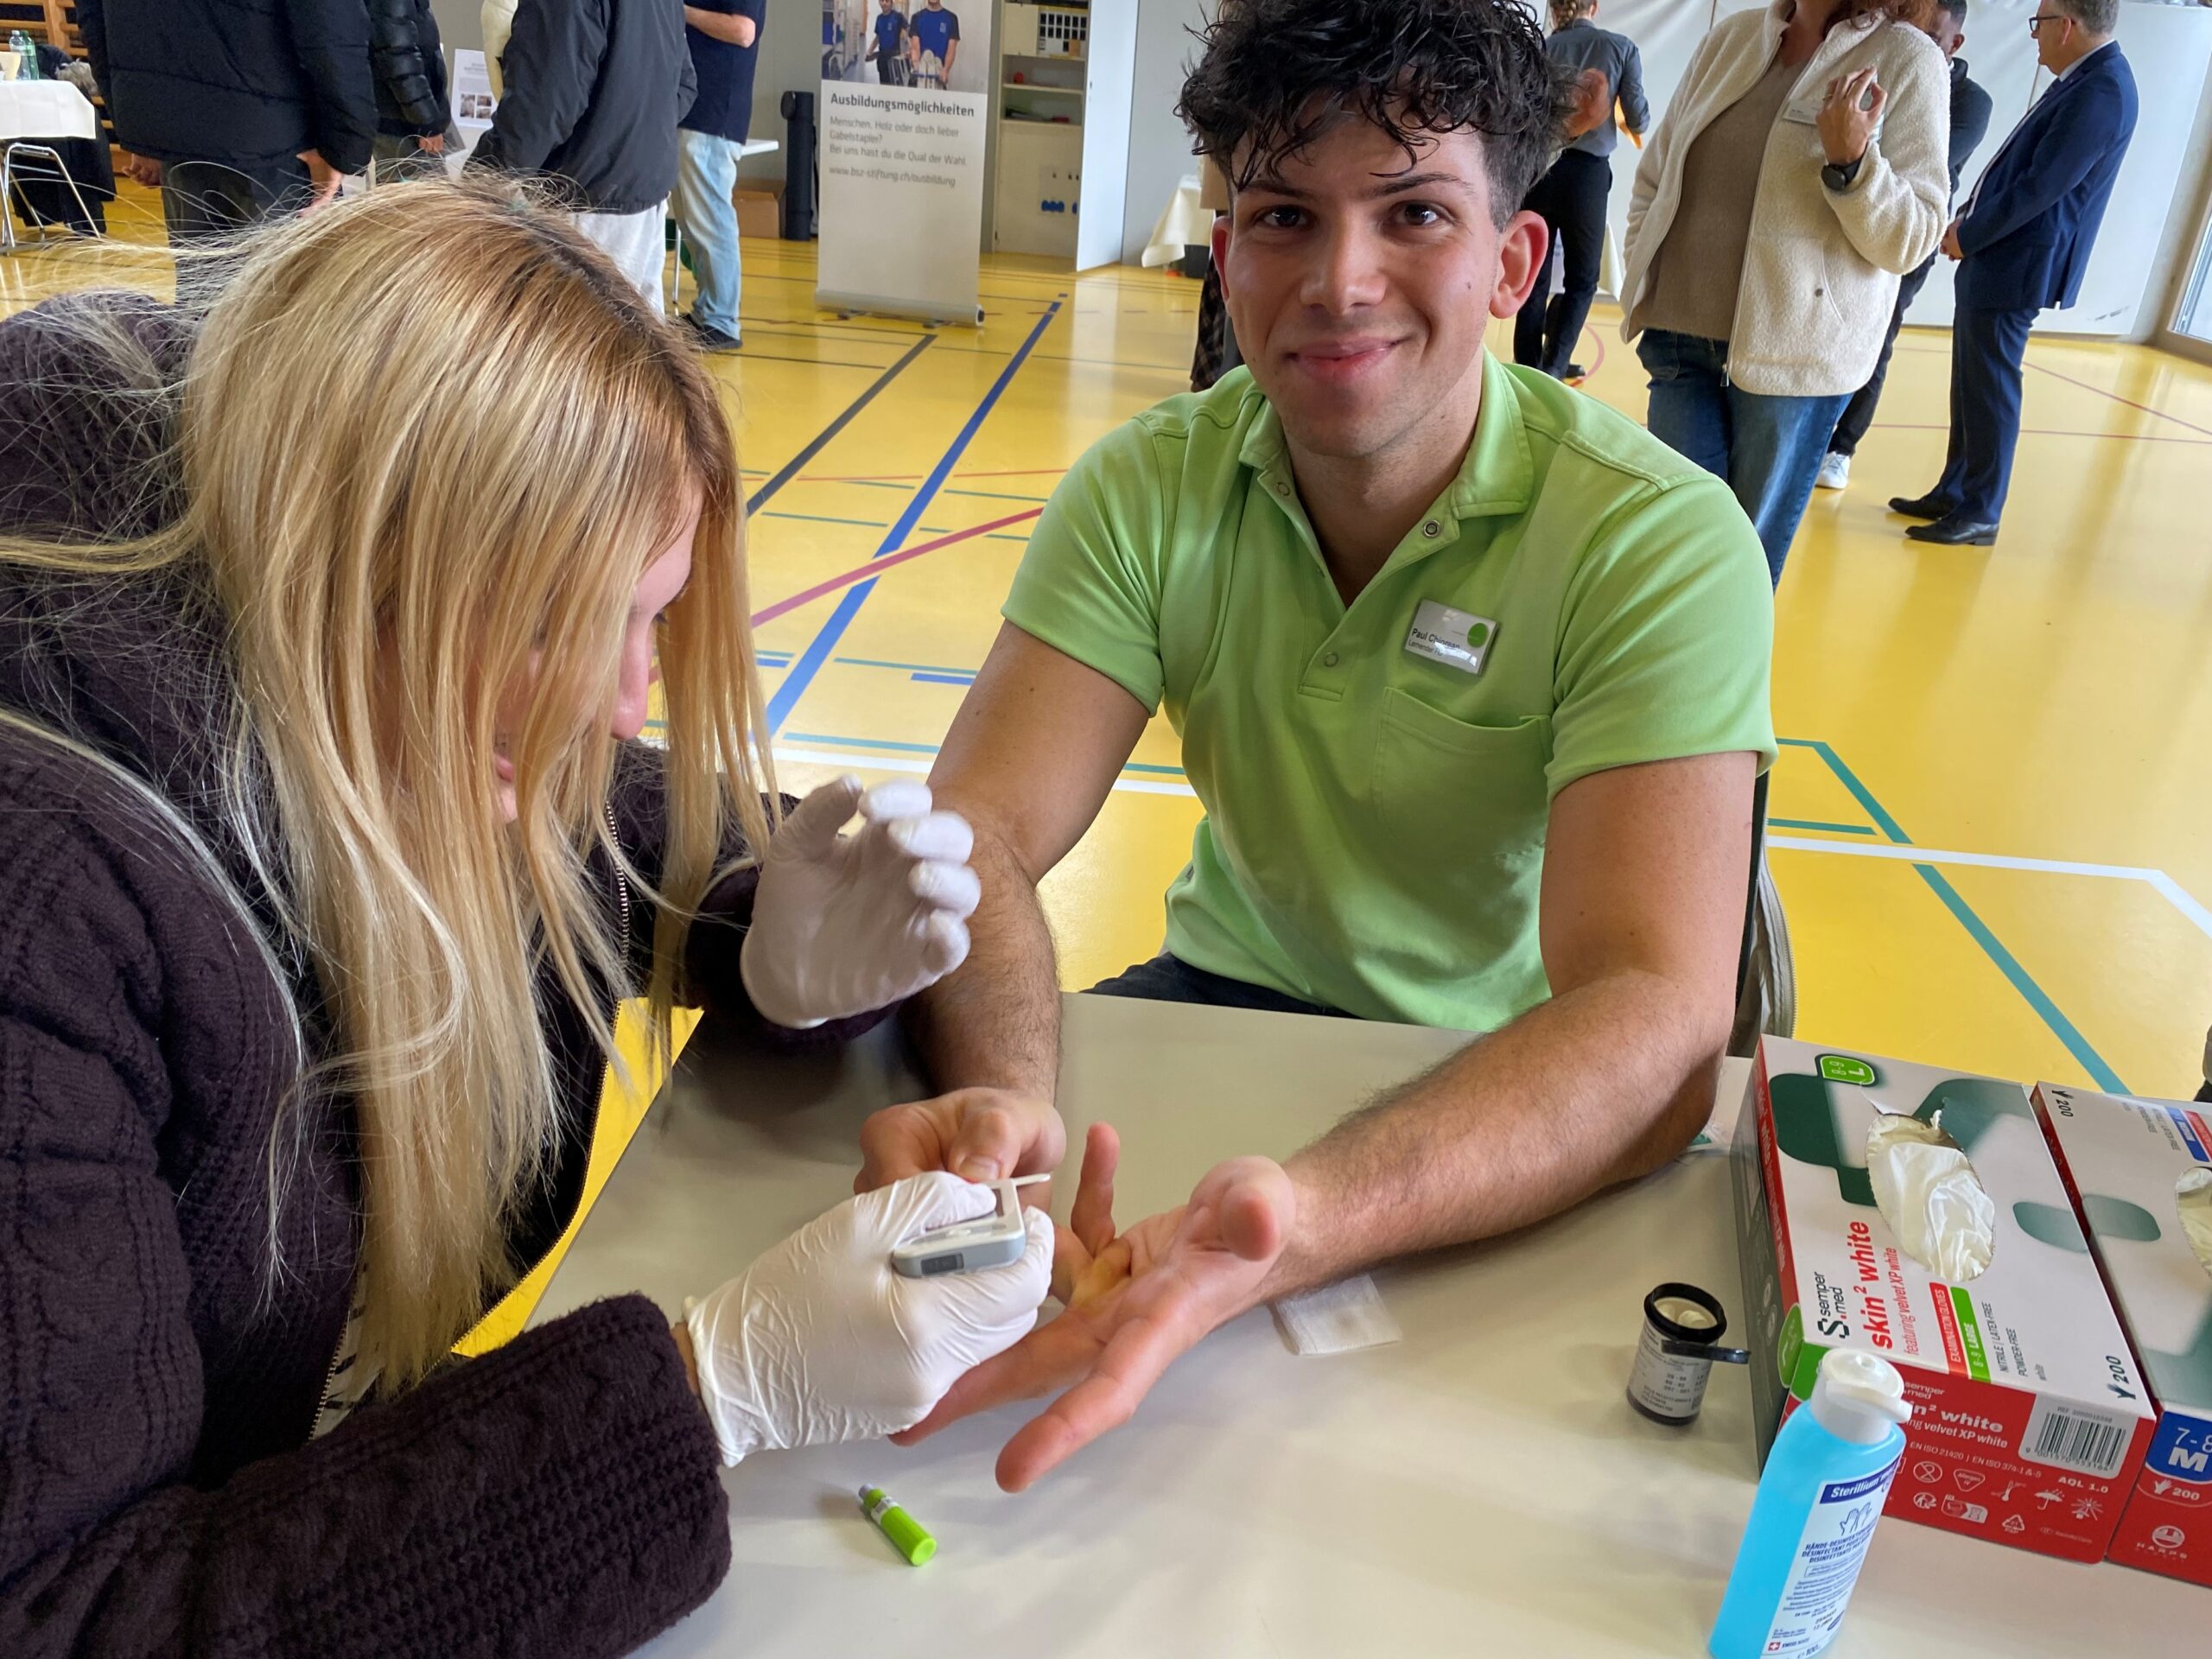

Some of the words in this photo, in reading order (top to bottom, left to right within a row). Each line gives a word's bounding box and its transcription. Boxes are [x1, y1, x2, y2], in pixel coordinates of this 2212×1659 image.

[830, 93, 975, 117] Ausbildungsmöglichkeiten
[830, 130, 882, 144] Gabelstapler?
[874, 121, 893, 131] Holz
[894, 124, 912, 133] oder
[915, 124, 935, 135] doch
[938, 125, 959, 137] lieber
[830, 143, 842, 153] Bei
[844, 147, 858, 156] uns
[861, 147, 879, 157] hast
[881, 149, 892, 159] du
[893, 150, 906, 161] die
[908, 151, 926, 162] Qual
[928, 154, 942, 163] der
[1412, 628, 1427, 640] Paul
[2056, 1099, 2074, 1118] 200
[1847, 1221, 1879, 1281] white
[1884, 1247, 1901, 1271] white
[1888, 1271, 1904, 1286] XP
[1815, 1271, 1831, 1317] semper
[1891, 1286, 1910, 1314] velvet
[1981, 1301, 2001, 1341] LATEX-FREE
[1899, 1315, 1919, 1355] featuring
[1963, 1322, 1980, 1350] LARGE
[1993, 1345, 2009, 1372] NITRILE
[2005, 1327, 2029, 1377] POWDER-FREE
[2105, 1355, 2130, 1384] 200
[1904, 1382, 1944, 1395] semper
[1941, 1409, 2004, 1433] white
[1924, 1421, 1957, 1436] velvet
[1958, 1428, 1976, 1440] XP
[1977, 1433, 2008, 1448] white
[1910, 1441, 1923, 1451] EN
[1923, 1444, 1939, 1454] ISO
[1939, 1446, 1965, 1460] 21420
[1973, 1455, 1986, 1465] EN
[1986, 1459, 2001, 1469] ISO
[2168, 1446, 2209, 1472] M
[1831, 1477, 1879, 1497] Sterillium
[2058, 1476, 2084, 1489] AQL
[2088, 1483, 2108, 1494] 1.0
[2172, 1487, 2200, 1501] 200
